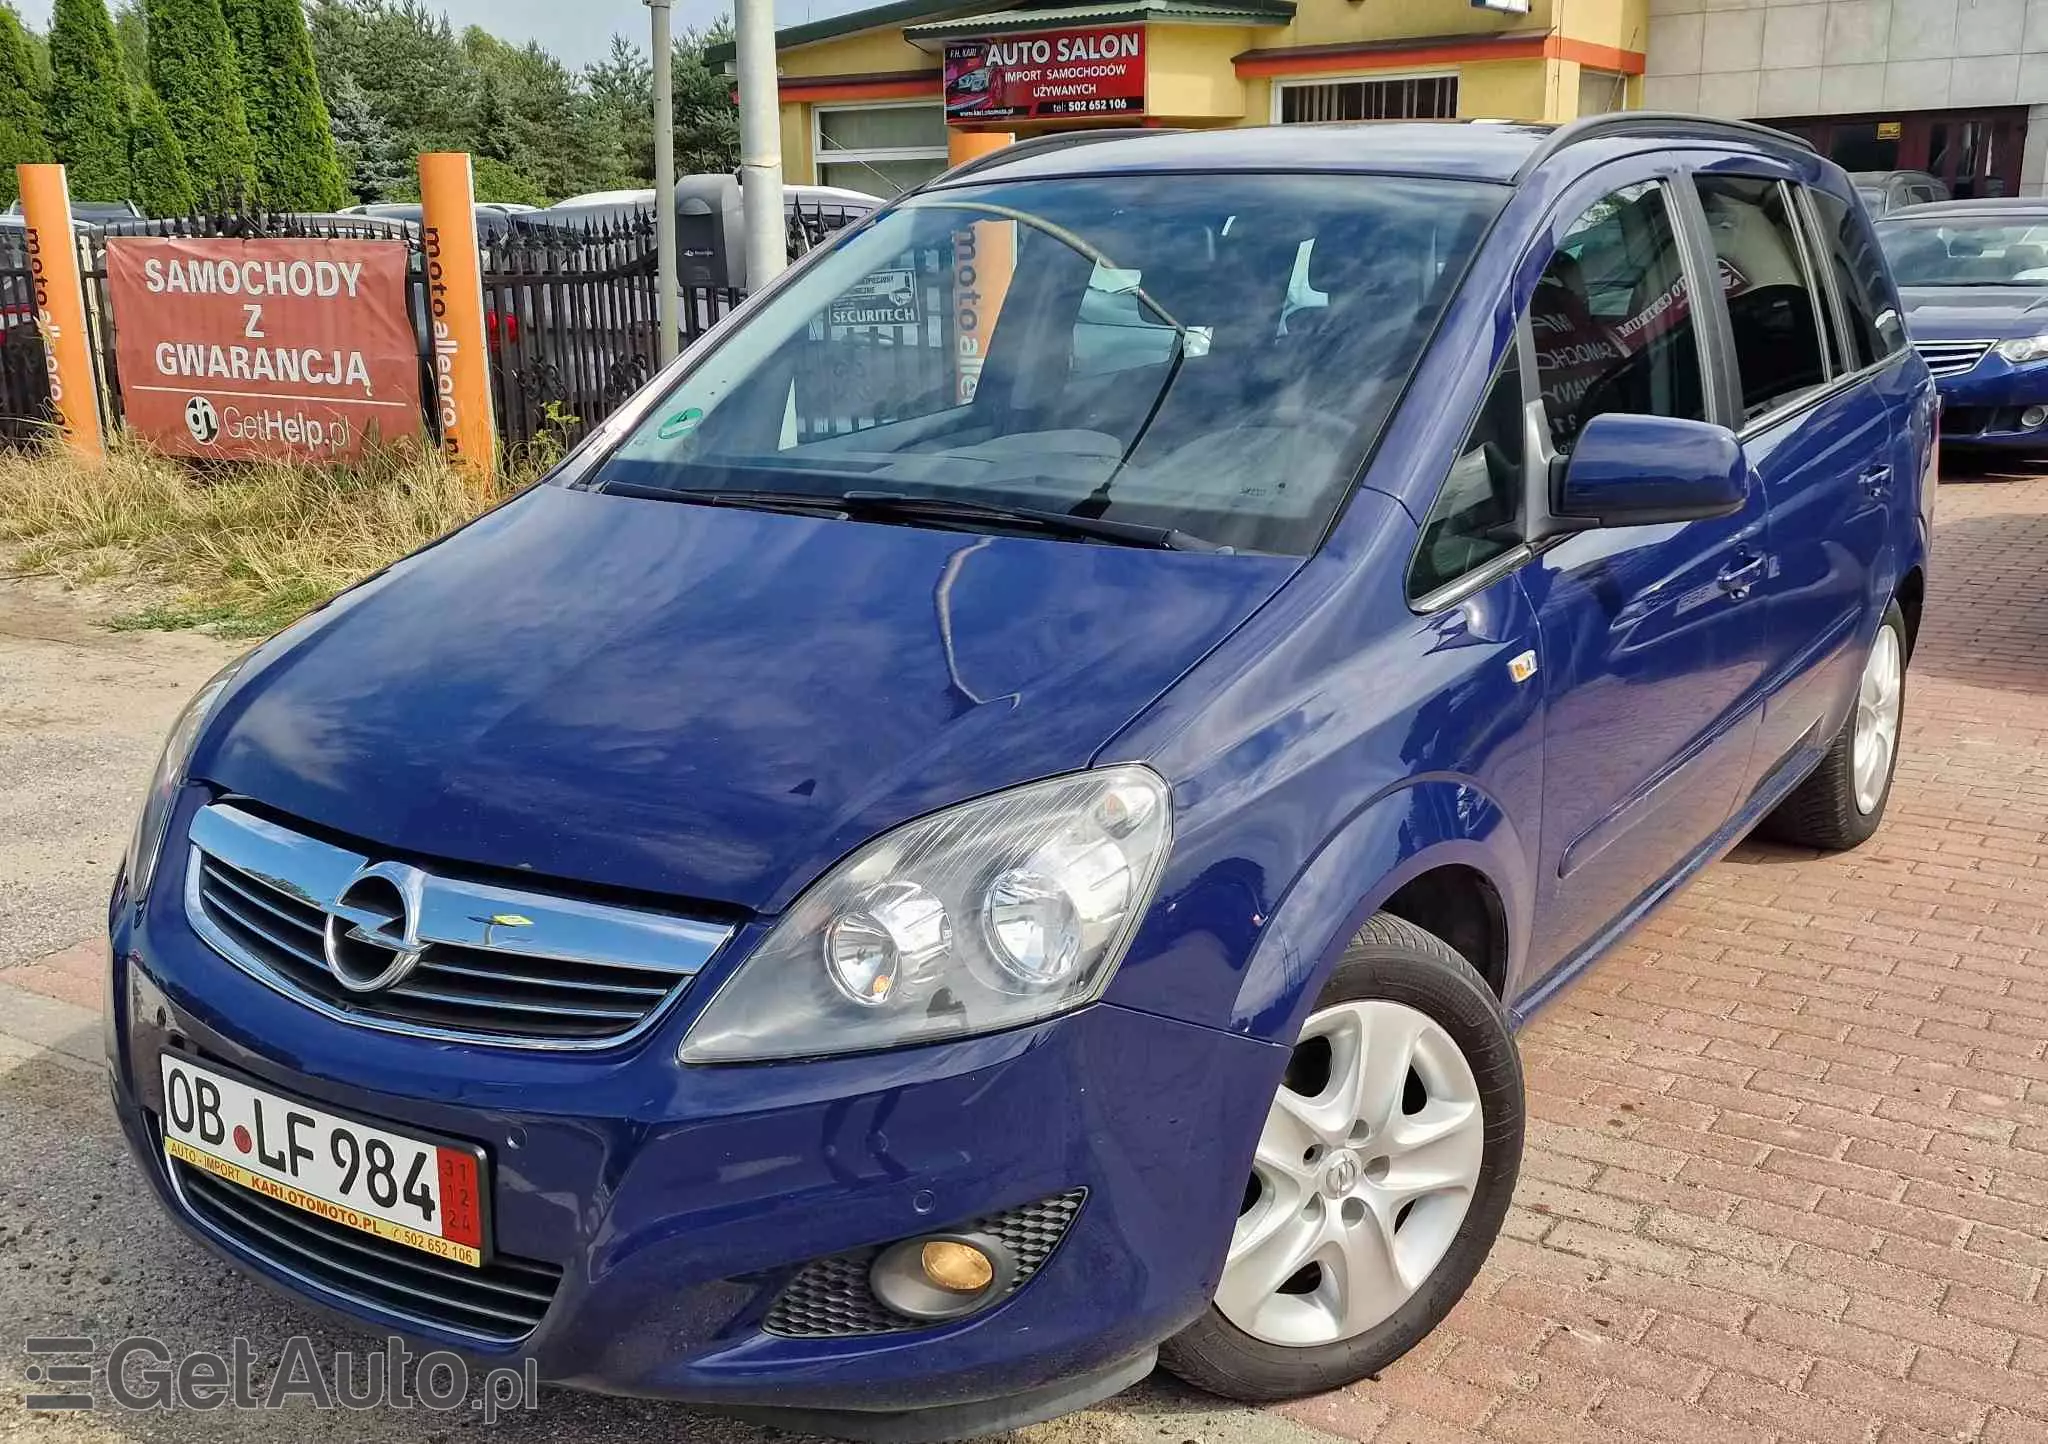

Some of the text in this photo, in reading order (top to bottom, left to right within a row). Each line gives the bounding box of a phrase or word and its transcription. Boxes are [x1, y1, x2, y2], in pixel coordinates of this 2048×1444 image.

[986, 33, 1139, 66] AUTO SALON
[1005, 64, 1126, 83] IMPORT SAMOCHODÓW
[1033, 84, 1096, 97] UŻYWANYCH
[1053, 99, 1127, 112] tel: 502 652 106
[145, 258, 362, 297] SAMOCHODY
[243, 304, 265, 338] Z
[833, 308, 915, 323] SECURITECH
[155, 342, 374, 397] GWARANCJĄ
[223, 405, 351, 454] GetHelp.pl
[168, 1067, 436, 1222] OB LF 984
[445, 1160, 469, 1183] 31
[171, 1143, 197, 1162] AUTO
[203, 1155, 240, 1180] IMPORT
[251, 1175, 382, 1235] KARI.OTOMOTO.PL
[404, 1226, 424, 1247] 502
[427, 1235, 449, 1256] 652
[452, 1245, 473, 1264] 106
[447, 1184, 469, 1207] 12
